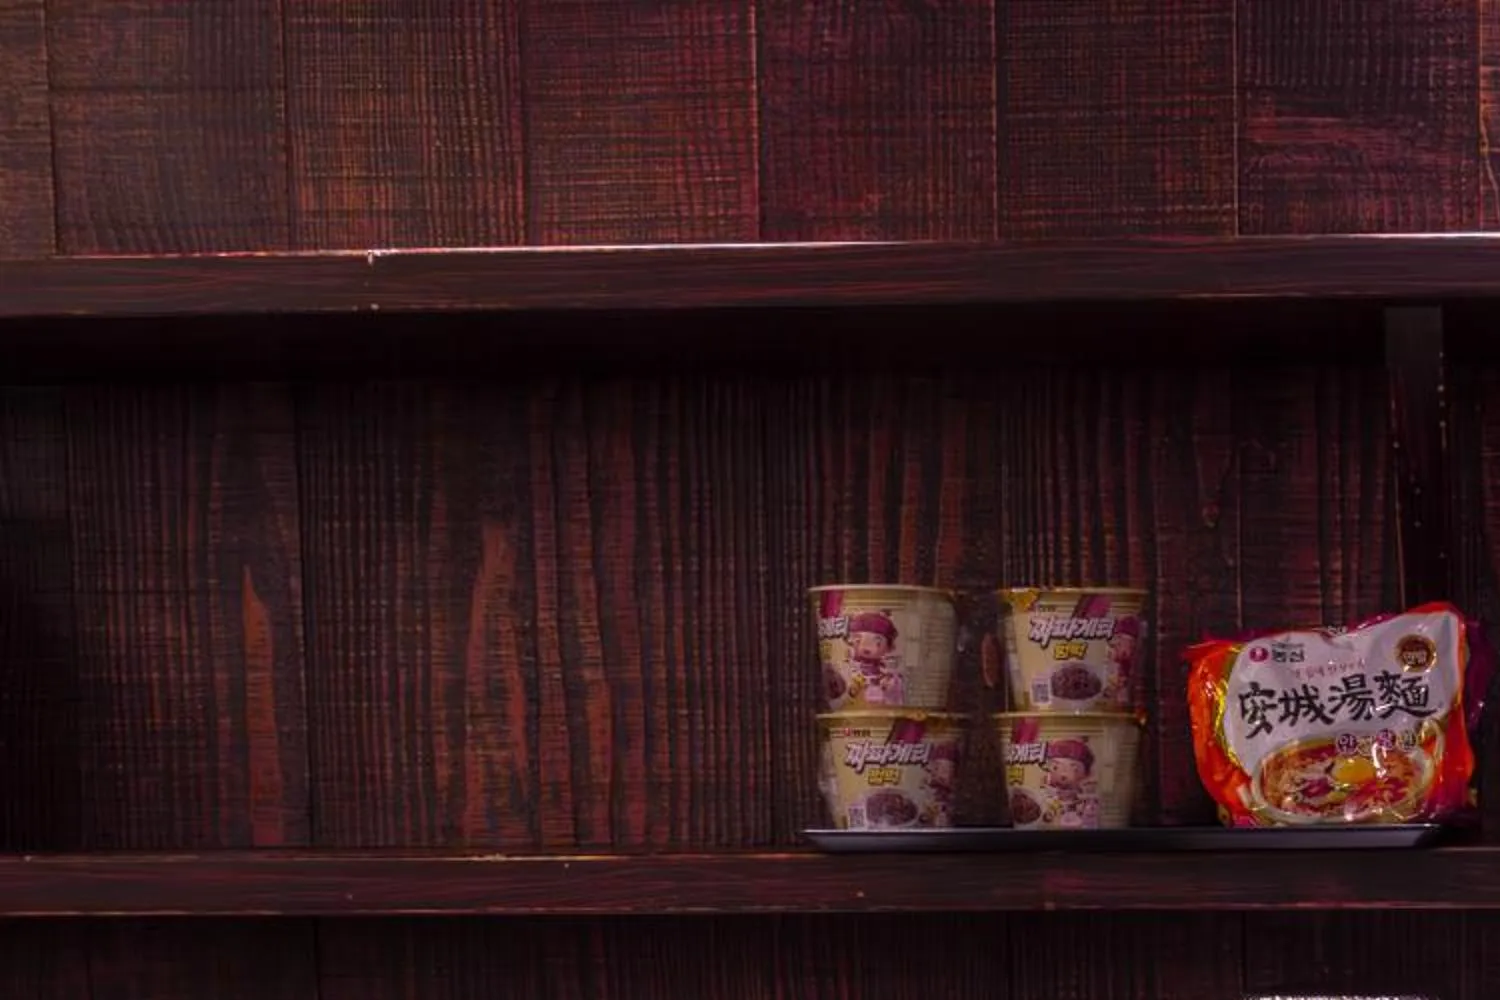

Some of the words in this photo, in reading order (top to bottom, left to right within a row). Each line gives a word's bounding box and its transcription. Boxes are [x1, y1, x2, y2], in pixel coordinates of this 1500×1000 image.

[1029, 614, 1117, 649] 짜파게티
[1238, 669, 1438, 739] 安城湯麵
[845, 740, 931, 774] 짜파게티
